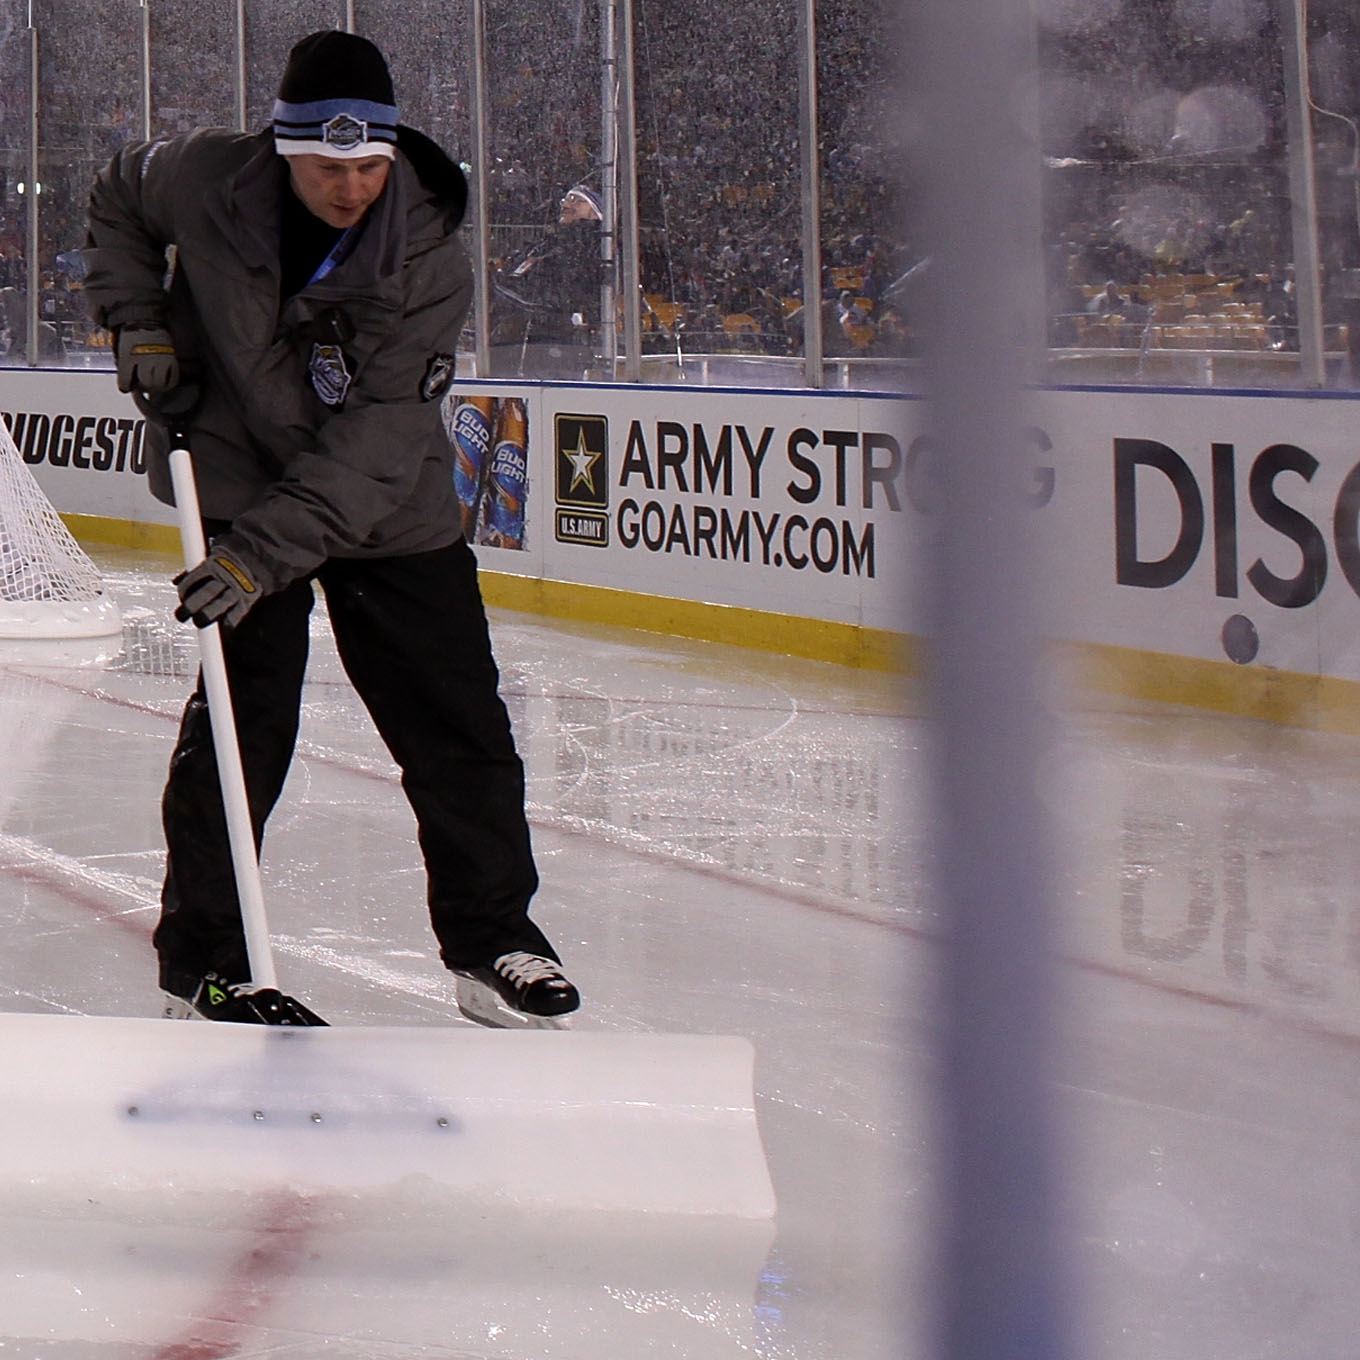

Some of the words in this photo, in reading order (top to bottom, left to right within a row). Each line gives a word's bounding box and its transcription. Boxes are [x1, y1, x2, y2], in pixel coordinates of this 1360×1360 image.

[459, 409, 490, 443] BUD
[491, 461, 527, 485] LIGHT
[496, 447, 526, 472] BUD
[618, 419, 776, 500] ARMY
[616, 497, 877, 580] GOARMY.COM
[1112, 436, 1360, 610] DIS
